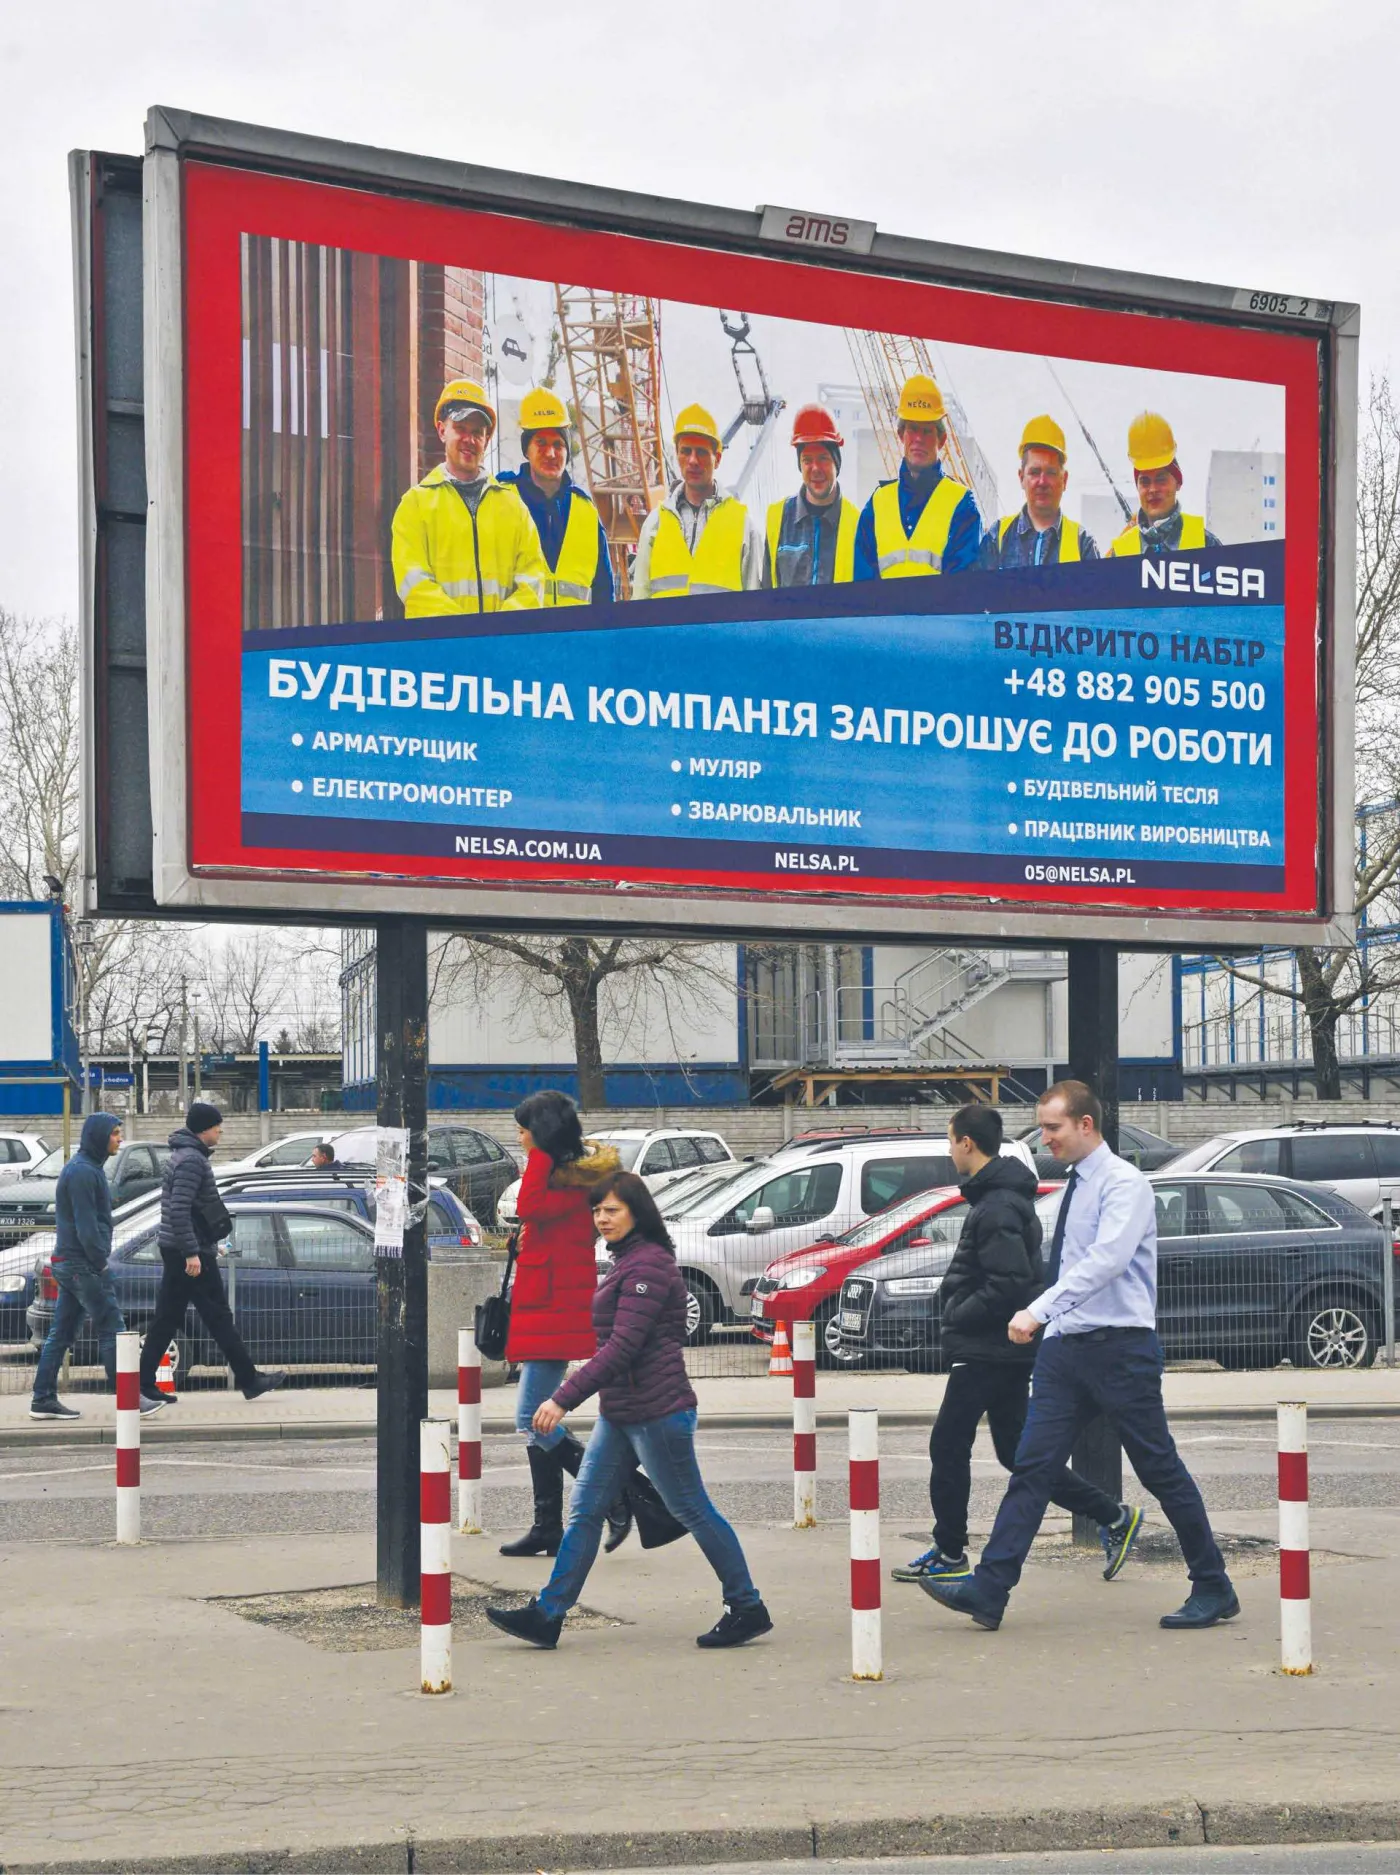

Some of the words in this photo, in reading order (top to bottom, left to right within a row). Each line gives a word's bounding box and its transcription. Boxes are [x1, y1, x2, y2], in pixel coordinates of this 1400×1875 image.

[786, 216, 849, 245] ams
[1250, 293, 1308, 316] 6905_2
[995, 621, 1159, 660] ВІДКРИТО
[1171, 635, 1264, 667] НАБІР
[1005, 668, 1065, 697] +48
[1077, 671, 1133, 701] 882
[1145, 676, 1199, 706] 905
[1212, 681, 1264, 710] 500
[270, 659, 573, 720] БУДІВЕЛЬНА
[589, 687, 816, 737] КОМПАНІЯ
[831, 705, 1052, 753] ЗАПРОШУЄ
[1063, 722, 1116, 762] ДО
[1130, 726, 1271, 765] РОБОТИ
[313, 732, 477, 762] АРМАТУРЩИК
[690, 758, 761, 778] МУЛЯР
[313, 778, 512, 807] ЕЛЕКТРОМОНТЕР
[1025, 780, 1156, 801] БУДІВЕЛЬНИЙ
[1163, 786, 1218, 804] ТЕСЛЯ
[689, 801, 861, 827] ЗВАРЮВАЛЬНИК
[1025, 821, 1135, 841] ПРАЦІВНИК
[1141, 826, 1270, 848] ВИРОБНИЦТВА
[456, 836, 602, 860] NELSA.COM.UA
[775, 852, 859, 871] NELSA.PL
[1025, 865, 1135, 883] 05@NELSA.PL
